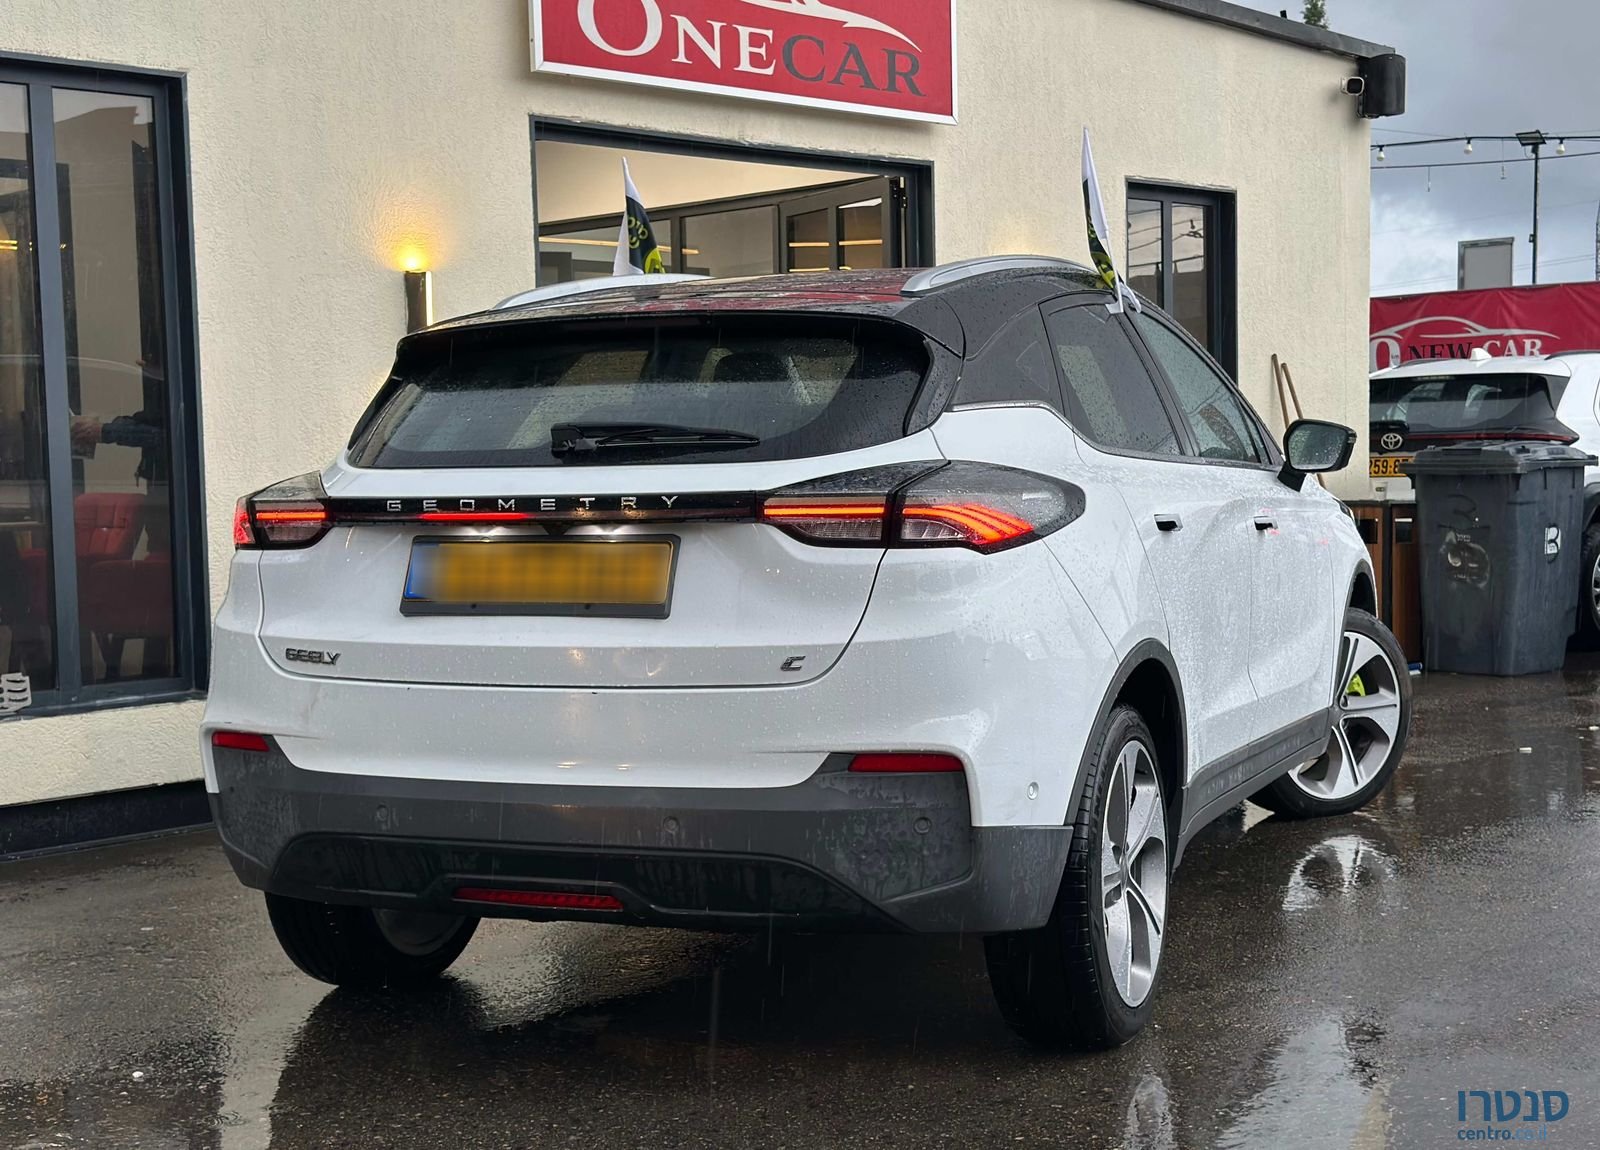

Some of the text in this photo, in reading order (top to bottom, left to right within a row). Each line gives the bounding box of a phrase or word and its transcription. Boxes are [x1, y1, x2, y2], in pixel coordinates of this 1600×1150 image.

[1484, 339, 1543, 357] CAR
[386, 495, 678, 512] GEOMETRY
[285, 648, 341, 665] GEELY
[780, 655, 806, 671] C
